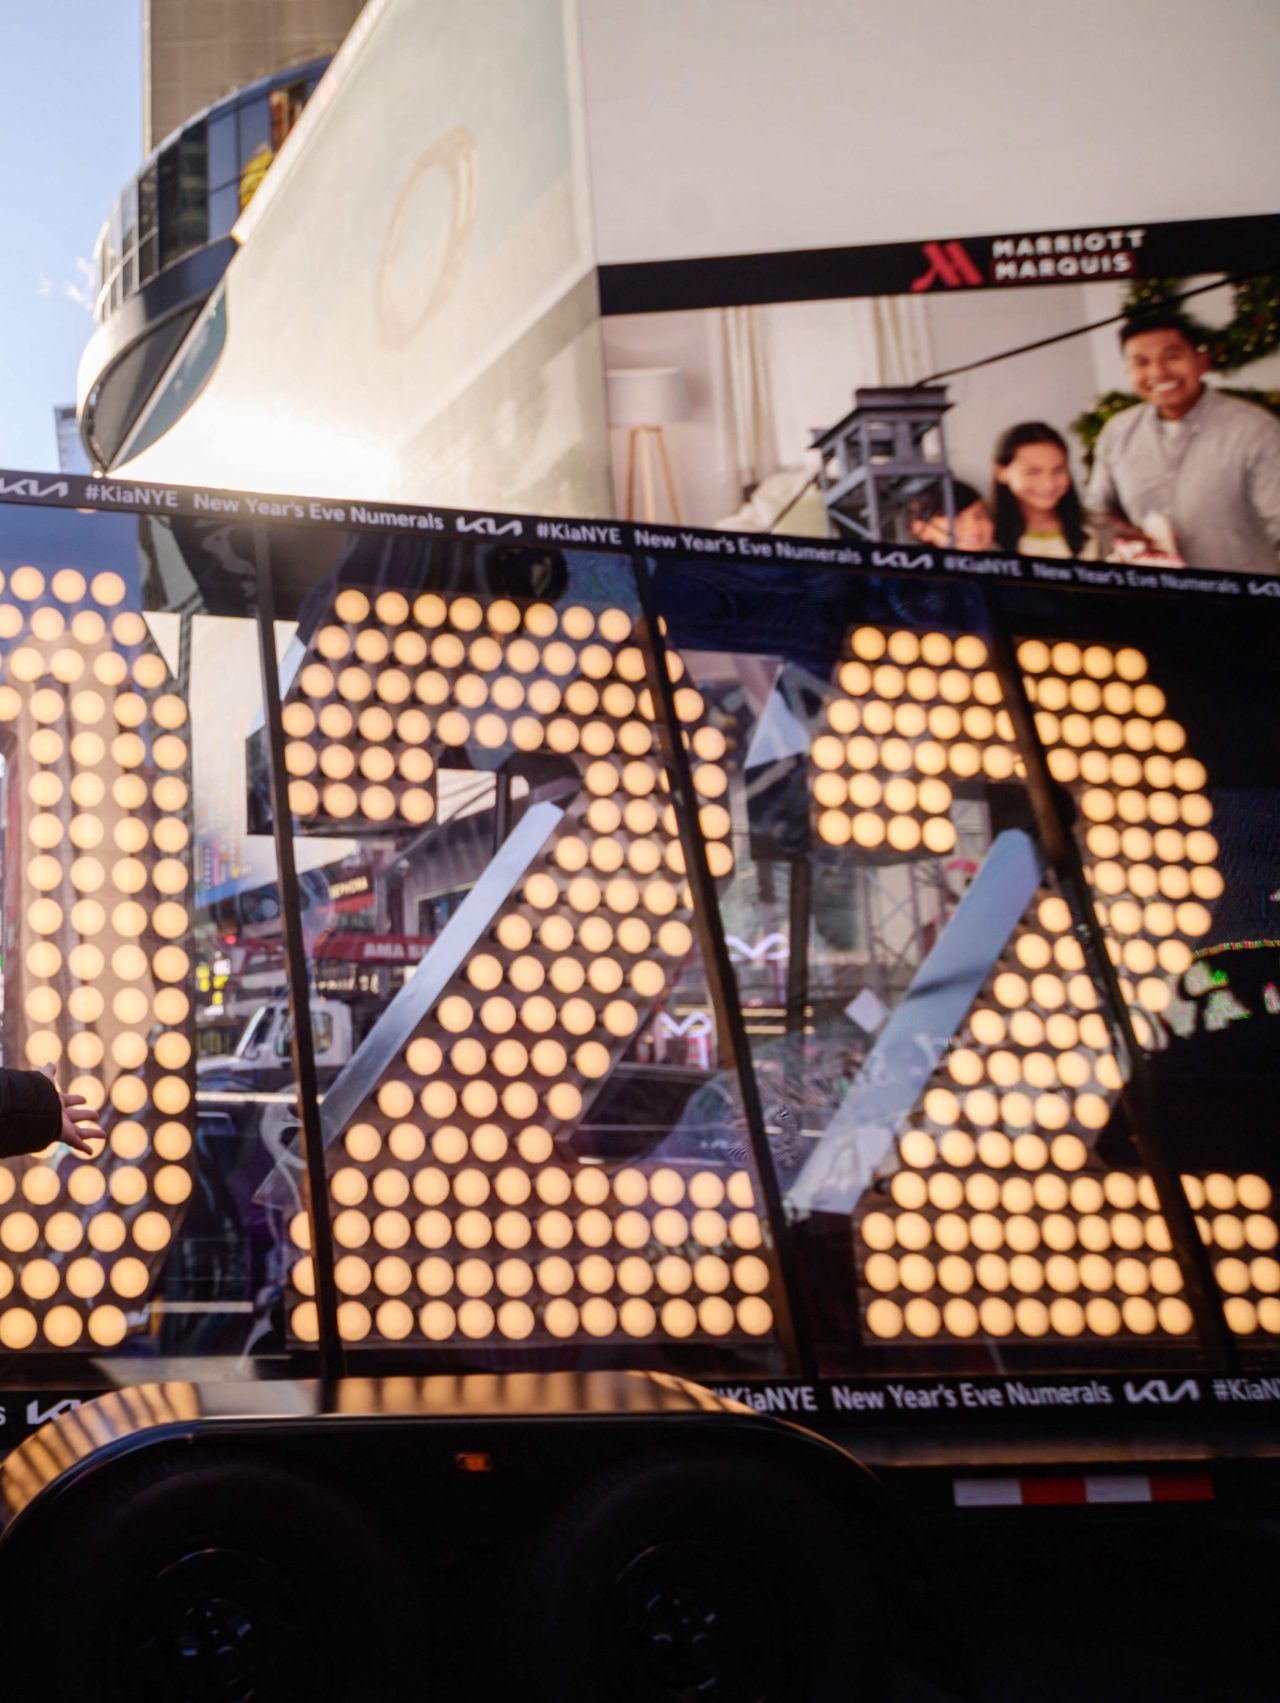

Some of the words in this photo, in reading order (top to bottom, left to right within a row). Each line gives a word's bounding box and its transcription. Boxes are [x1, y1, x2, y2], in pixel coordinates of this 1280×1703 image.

[992, 229, 1146, 259] MARRIOTT
[995, 252, 1132, 281] MARQUIS
[85, 484, 178, 508] #KiaNYE
[193, 493, 239, 513] New
[245, 498, 304, 518] Year's
[309, 503, 345, 522] Eve
[350, 506, 444, 531] Numerals
[536, 522, 622, 545] #KiaNYE
[634, 529, 676, 549] New
[681, 534, 735, 554] Year's
[738, 538, 771, 557] Eve
[776, 541, 862, 565] Numerals
[1032, 562, 1071, 581] New
[831, 1385, 885, 1410] New
[886, 1384, 958, 1409] Year's
[959, 1382, 1003, 1407] Eve
[1005, 1379, 1113, 1406] Numerals
[1211, 1377, 1280, 1402] #KiaN
